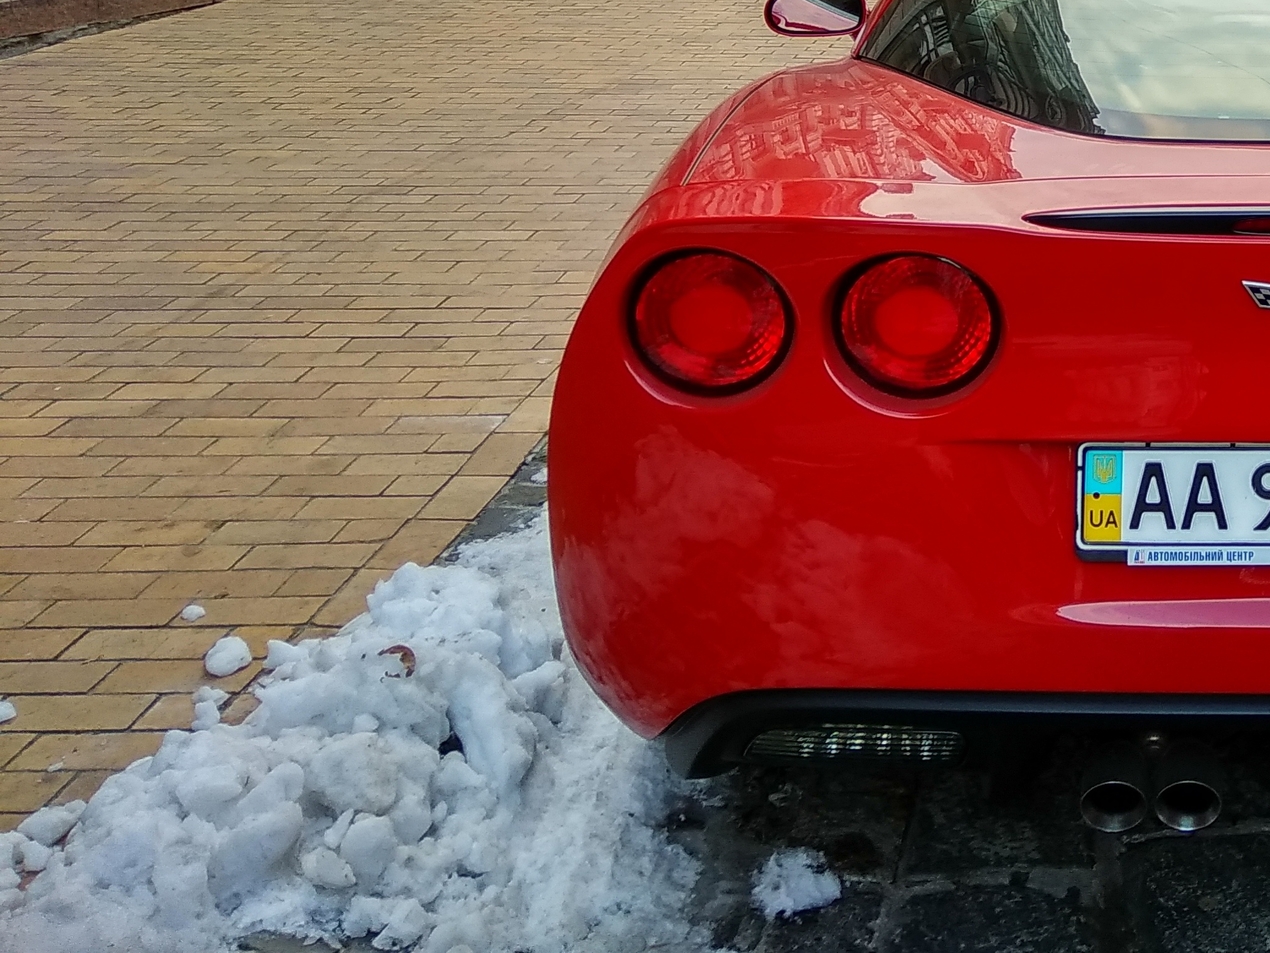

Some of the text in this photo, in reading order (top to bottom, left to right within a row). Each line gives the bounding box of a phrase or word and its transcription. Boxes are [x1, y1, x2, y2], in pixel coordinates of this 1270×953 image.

[1129, 462, 1229, 531] AA
[1090, 509, 1118, 528] UA
[1147, 549, 1224, 562] АВТОМОБІЛЬНИЙ
[1226, 551, 1255, 564] ЦЕНТР
